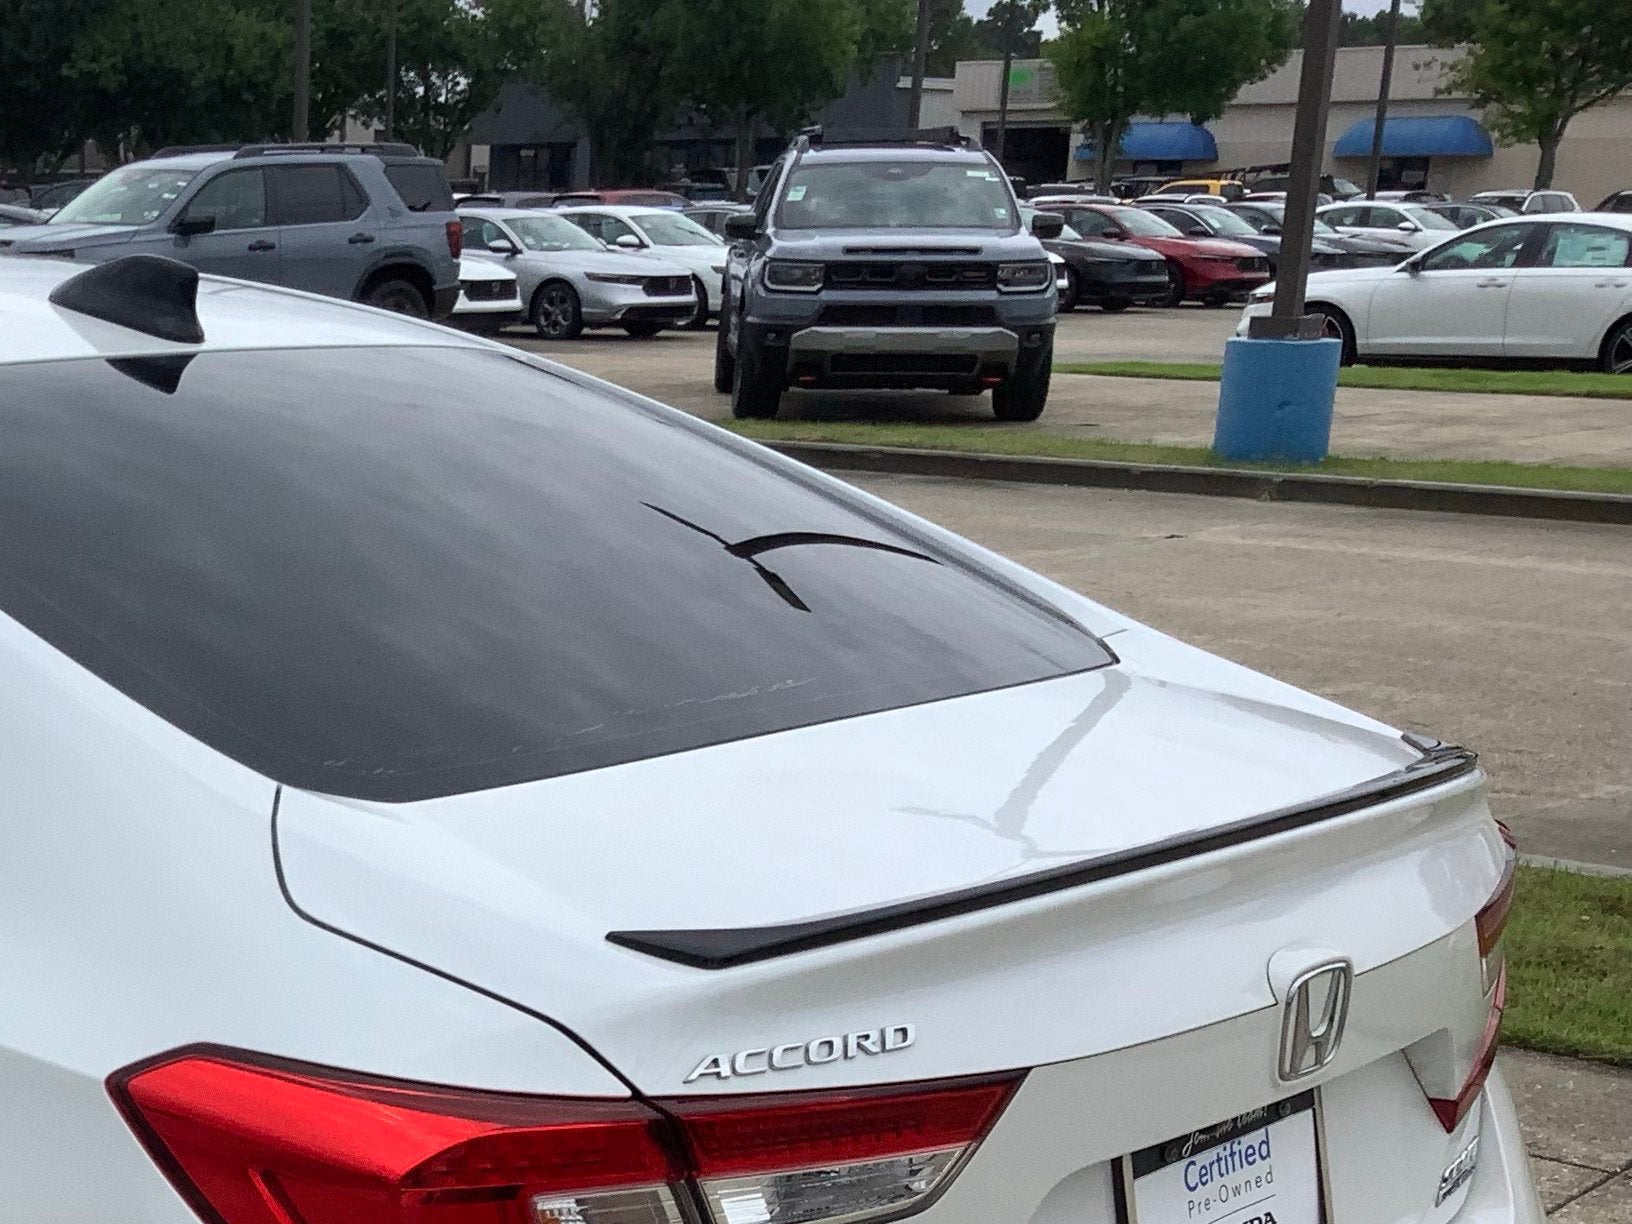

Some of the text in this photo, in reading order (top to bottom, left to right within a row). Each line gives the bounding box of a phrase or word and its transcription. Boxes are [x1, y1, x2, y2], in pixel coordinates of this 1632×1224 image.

[682, 1023, 916, 1084] ACCORD
[1184, 1127, 1271, 1192] Certified
[1187, 1165, 1274, 1219] Pre-Owned
